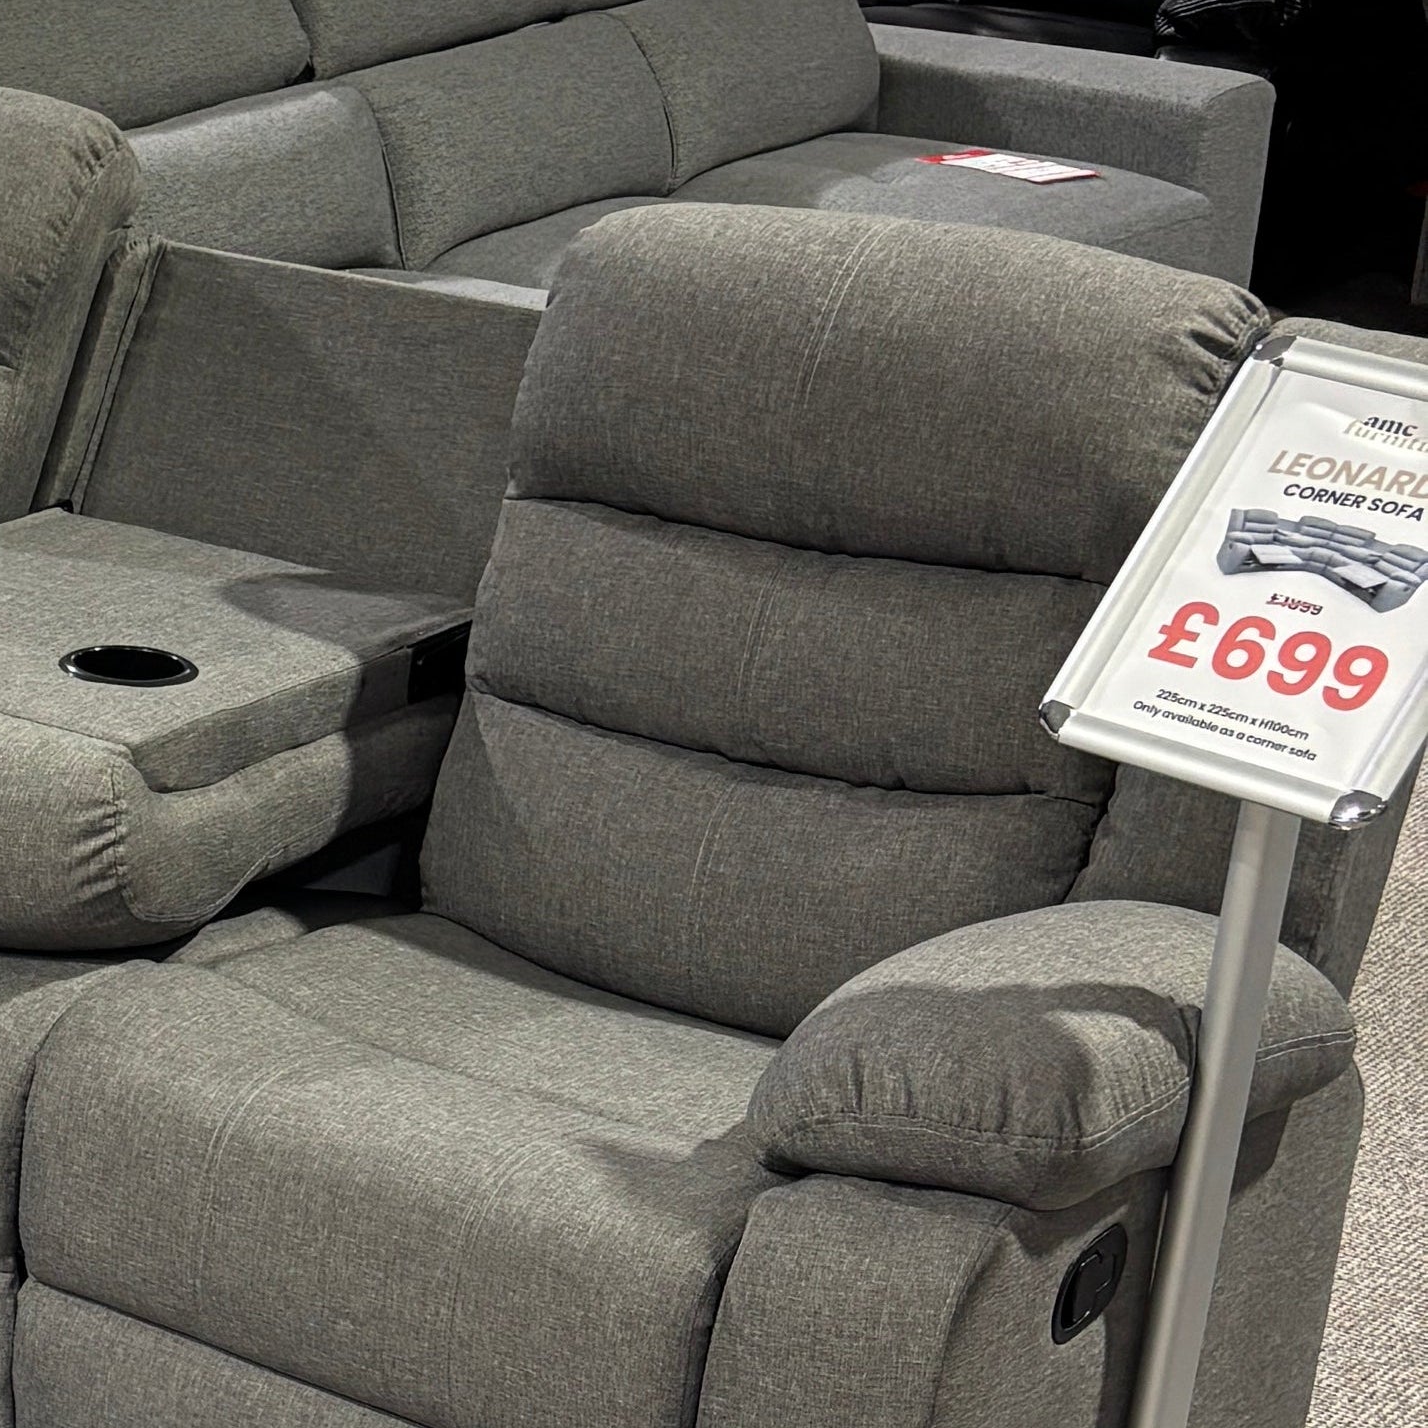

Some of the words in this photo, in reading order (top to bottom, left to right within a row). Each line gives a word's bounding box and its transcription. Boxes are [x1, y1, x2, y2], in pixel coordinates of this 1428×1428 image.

[1361, 416, 1418, 437] amc
[1283, 483, 1367, 509] CORNER
[1367, 498, 1425, 522] SOFA
[1148, 601, 1389, 711] £699
[1133, 699, 1161, 719] Only
[1161, 709, 1219, 733] available
[1219, 728, 1235, 738] as
[1246, 735, 1289, 754] corner
[1289, 744, 1317, 762] sofa
[1156, 688, 1197, 710] 225cm
[1207, 703, 1249, 725] 225cm
[1259, 717, 1310, 741] H100cm
